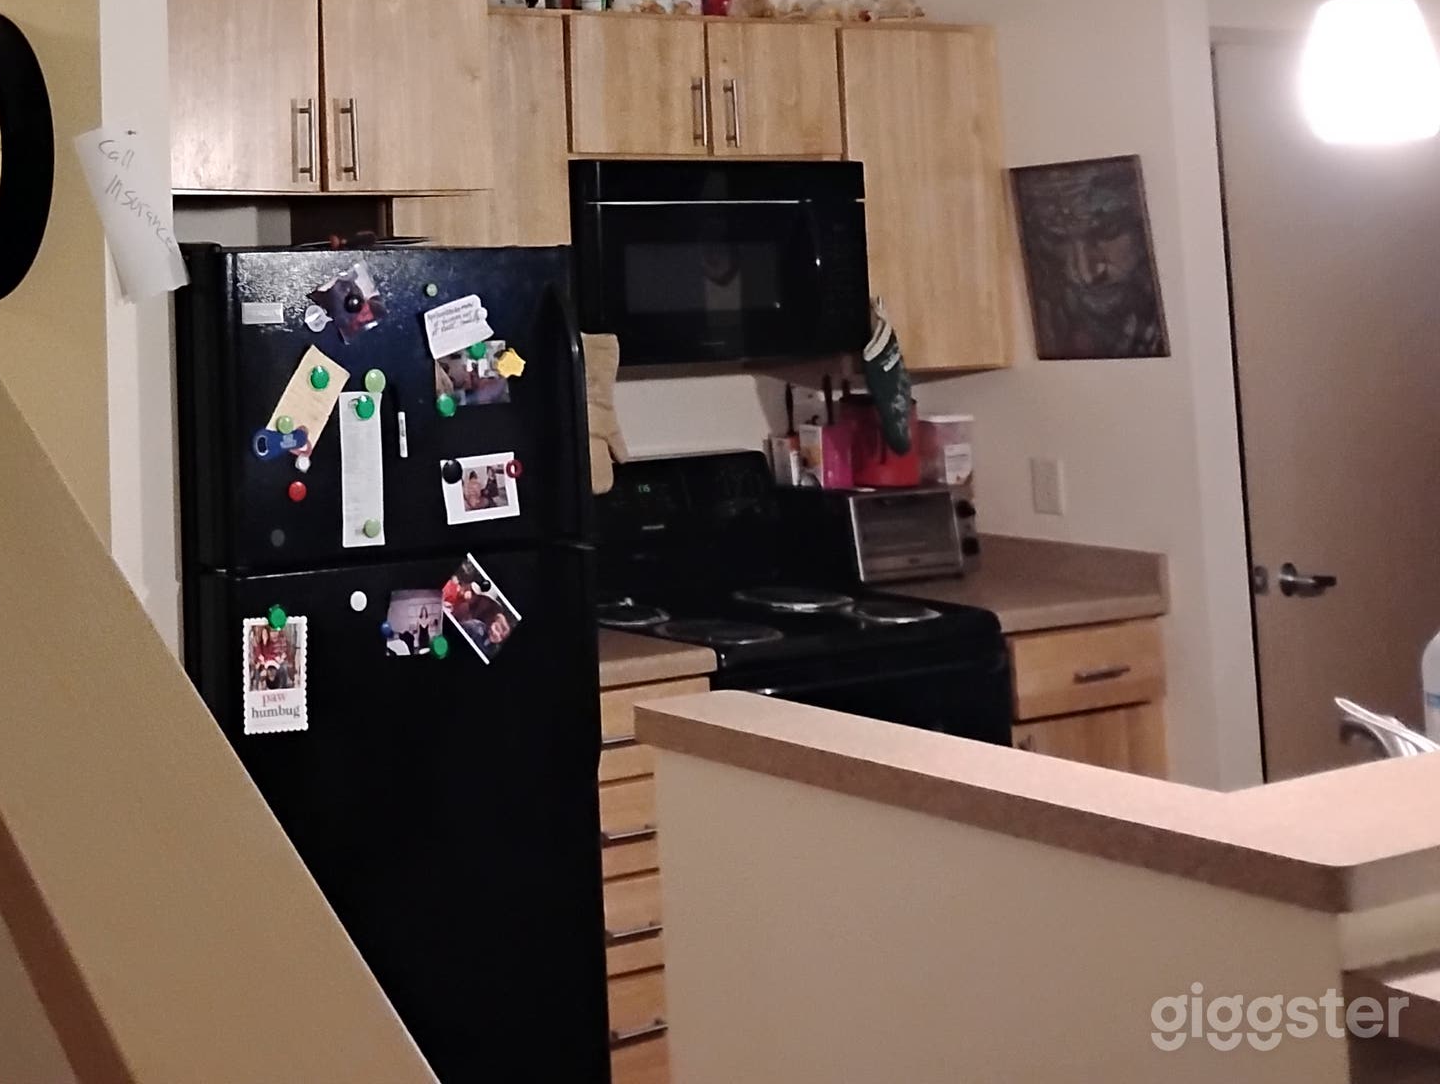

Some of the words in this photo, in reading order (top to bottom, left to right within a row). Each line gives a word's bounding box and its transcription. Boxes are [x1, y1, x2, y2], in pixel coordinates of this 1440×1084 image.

[98, 139, 135, 170] Call
[262, 692, 286, 707] paw
[251, 705, 301, 719] humbug
